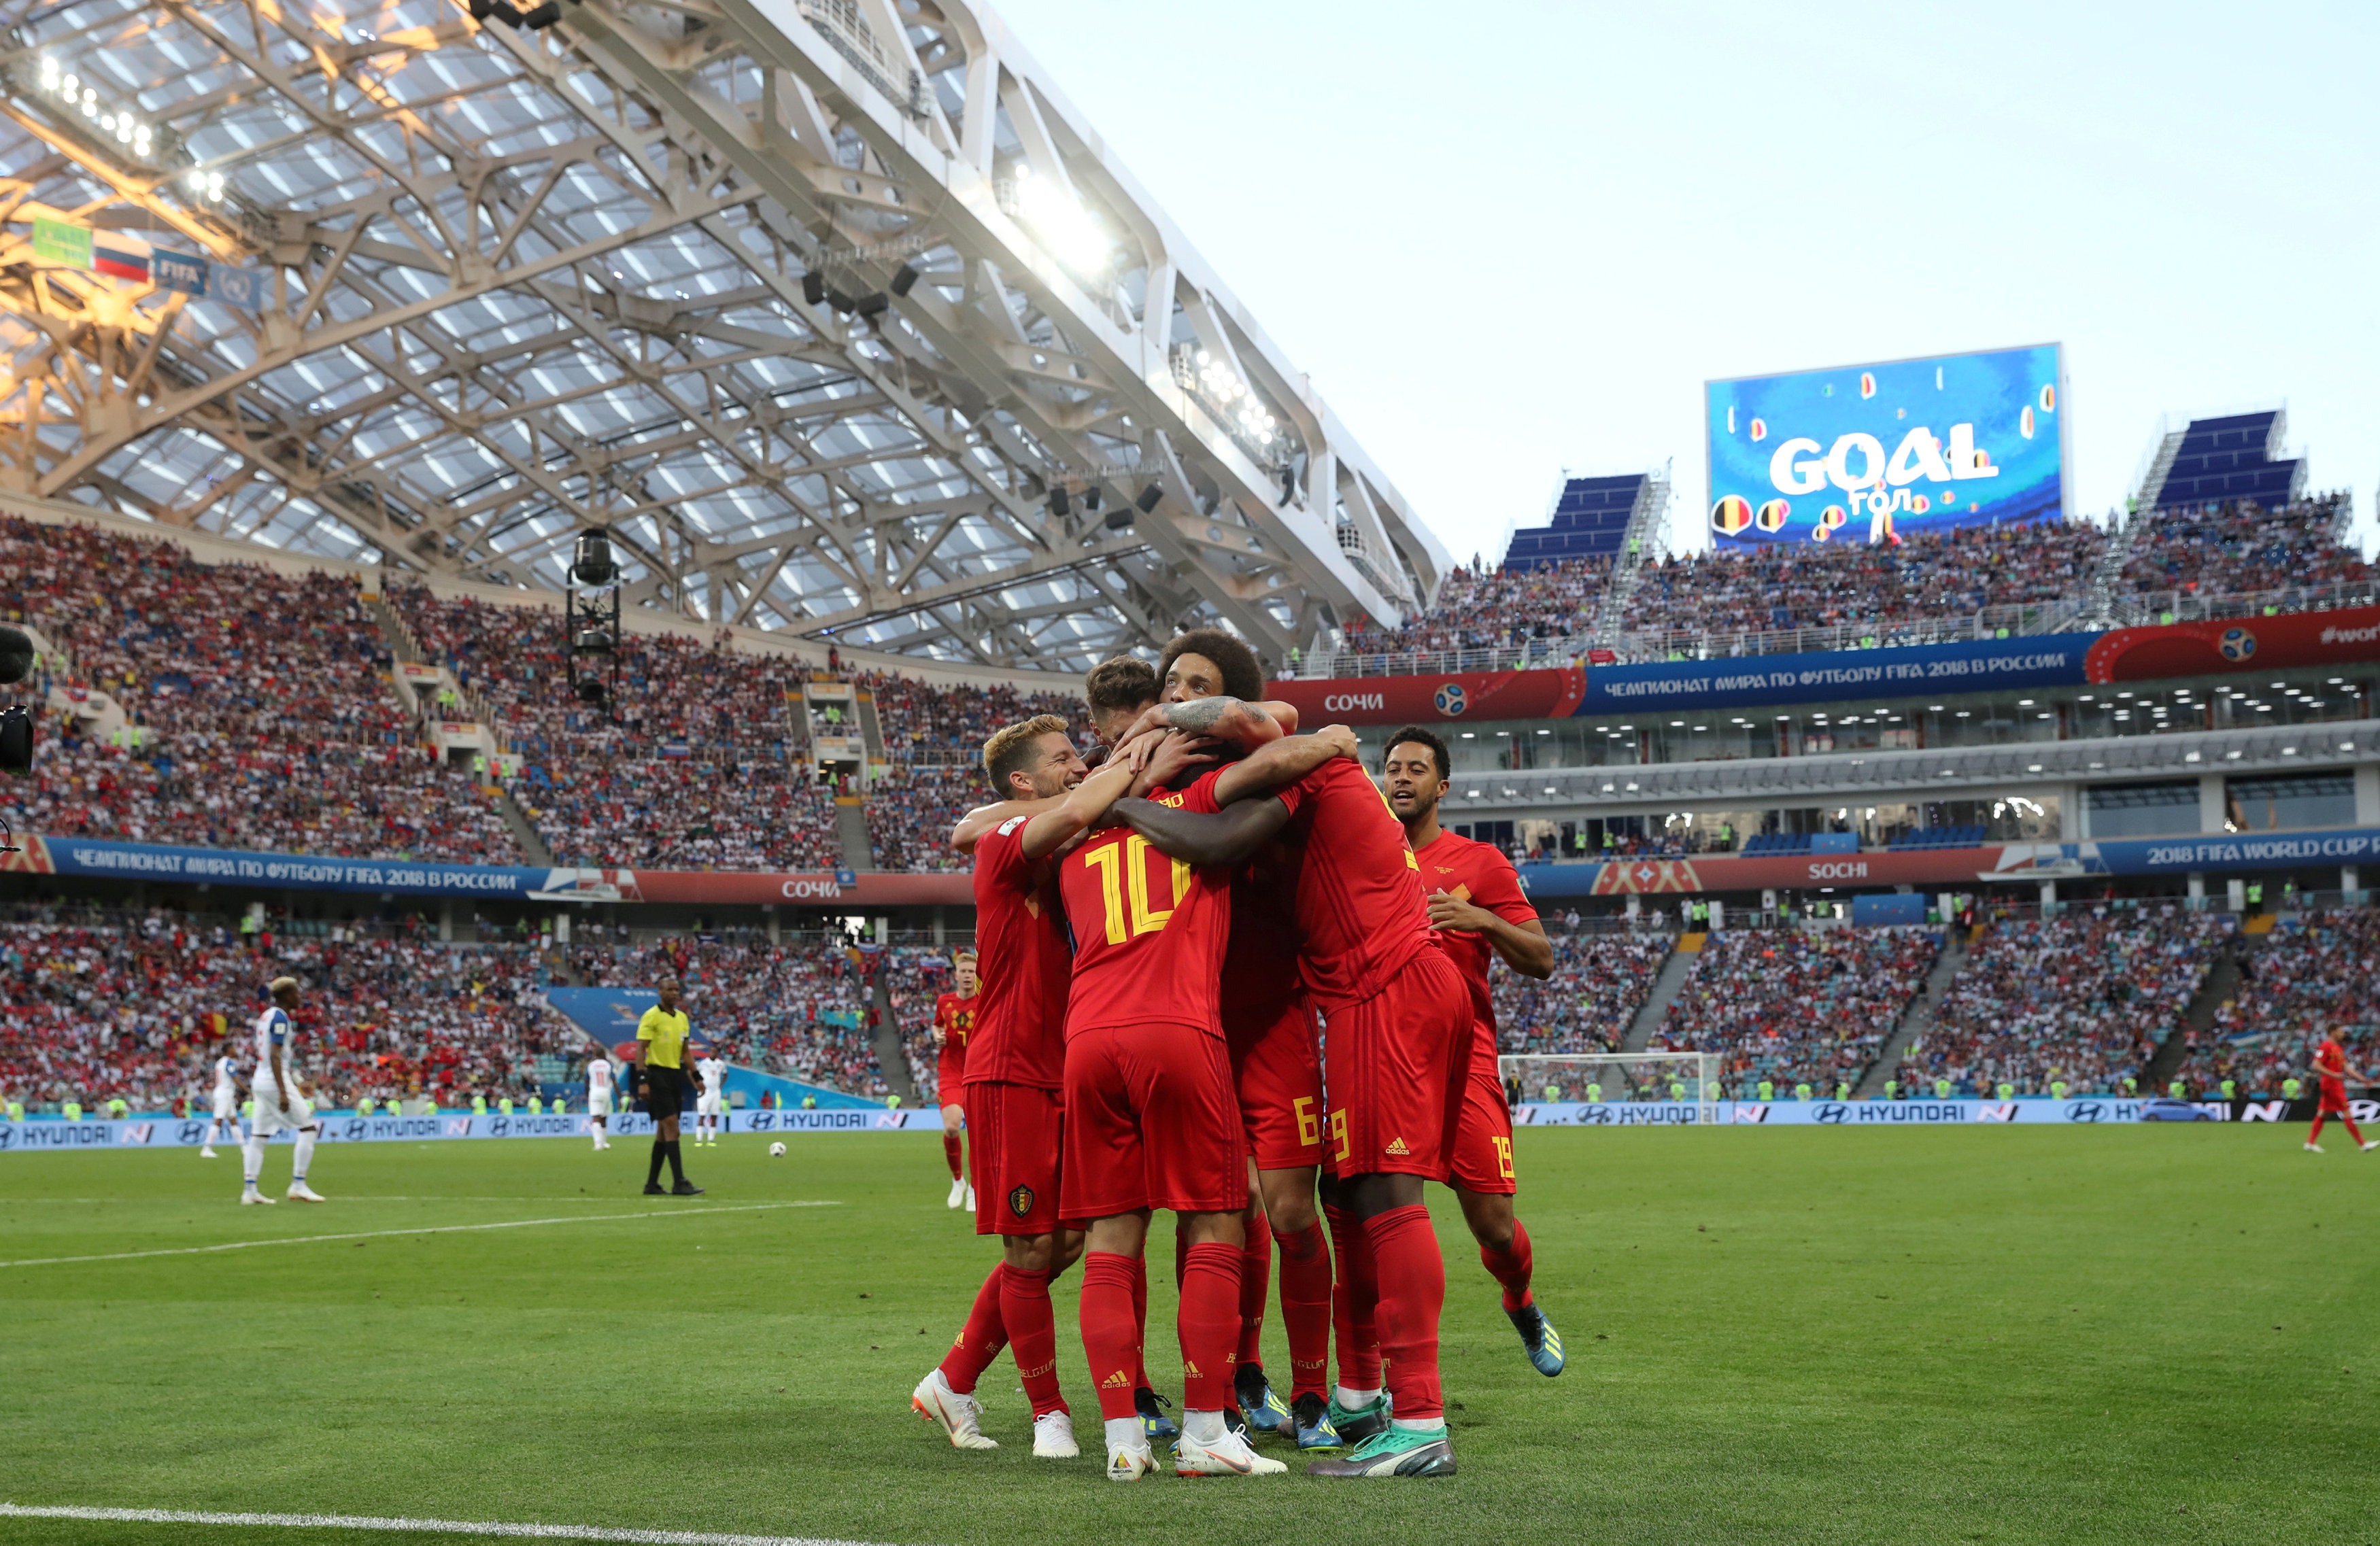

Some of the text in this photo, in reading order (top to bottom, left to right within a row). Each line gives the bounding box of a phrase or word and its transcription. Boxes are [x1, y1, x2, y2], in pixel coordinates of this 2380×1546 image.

[160, 259, 200, 283] FIFA
[1770, 422, 1999, 495] GOAL
[2319, 623, 2380, 645] #wor
[1605, 678, 1710, 697] ЧЕМПИОНАТ
[1715, 674, 1767, 691] МИРА
[1770, 672, 1797, 687] ПО
[1799, 664, 1882, 685] ФУТБОЛУ
[1886, 662, 1924, 679] FIFA
[1927, 659, 1969, 677] 2018
[1988, 653, 2065, 672] РОССИИ
[1324, 693, 1384, 712] СОЧИ
[2147, 846, 2195, 865] 2018
[2196, 844, 2241, 862] FIFA
[2243, 839, 2320, 860] WORLD
[2322, 837, 2369, 856] CUP
[73, 848, 183, 873] ЧЕМПИОНАТ
[186, 857, 237, 876] МИРА
[239, 859, 263, 878] ПО
[267, 863, 342, 883] ФУТБОЛУ
[345, 867, 383, 884] FIFA
[386, 869, 426, 887] 2018
[443, 872, 516, 891] РОССИИ
[1809, 861, 1868, 880] SOCHI
[781, 880, 841, 898] СОЧИ
[1085, 834, 1191, 946] 10
[957, 1031, 967, 1047] 7
[783, 1114, 866, 1128] HYUNDAI
[1293, 1095, 1320, 1146] 6
[1860, 1105, 1965, 1120] HYUNDAI
[22, 1124, 112, 1145] HYUNDAI
[375, 1120, 441, 1136] HYUNDAI
[515, 1119, 575, 1133] HYUNDAI
[1331, 1107, 1350, 1163] 9
[1491, 1136, 1516, 1178] 19
